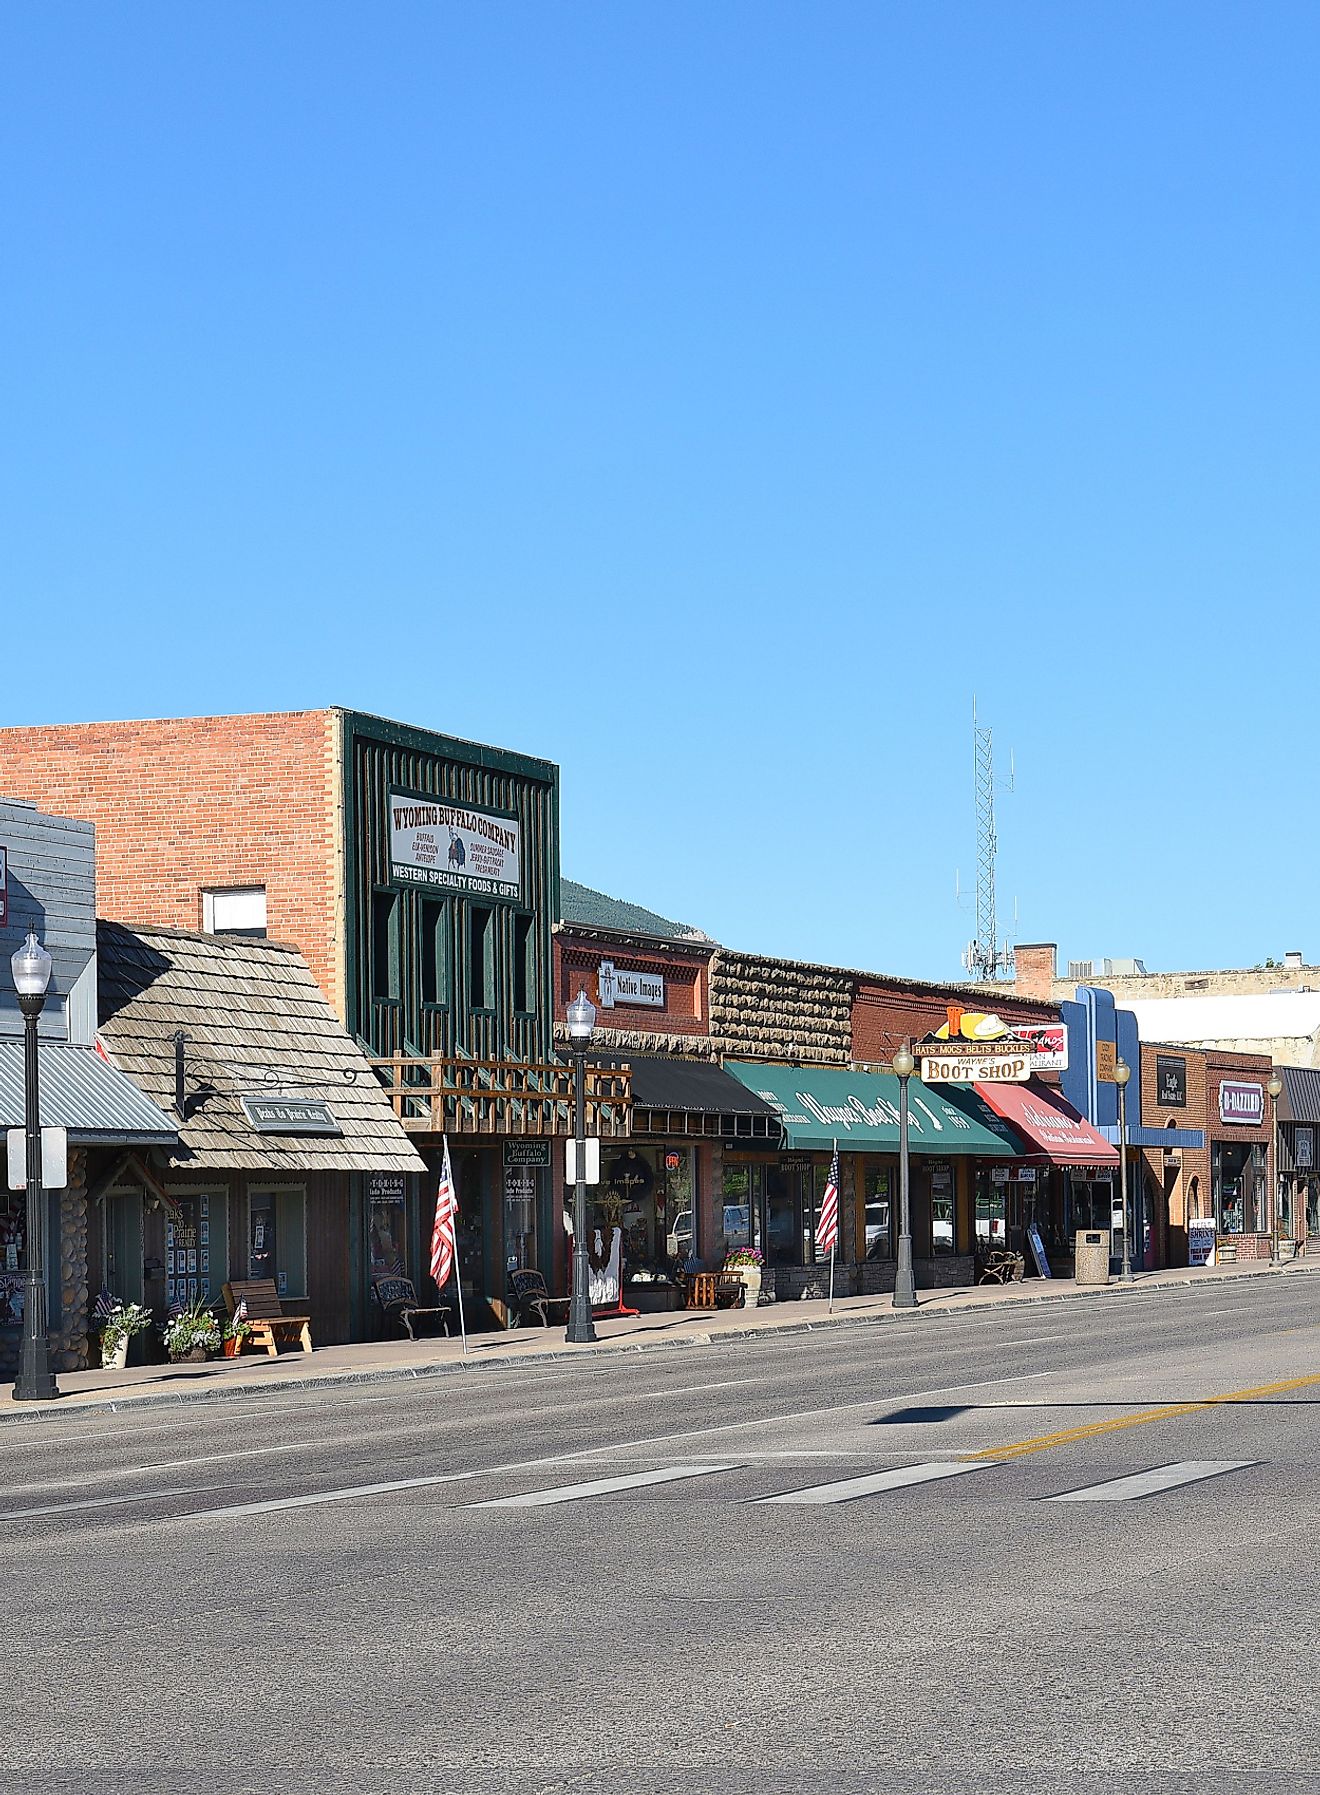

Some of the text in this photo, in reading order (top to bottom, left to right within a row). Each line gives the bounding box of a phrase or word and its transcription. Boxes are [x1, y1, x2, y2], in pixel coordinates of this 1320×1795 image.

[393, 807, 516, 854] WYOMING BUFFALO COMPANY
[392, 864, 519, 898] WESTERN SPECIALTY FOODS & GIFTS
[616, 975, 662, 1001] Native Images
[915, 1044, 1031, 1054] HATS MOCS BELTS BUCKLES
[957, 1057, 996, 1066] WAYNE'S
[927, 1059, 1026, 1080] BOOT SHOP
[508, 1141, 547, 1151] Wyoming
[512, 1149, 542, 1158] Buffalo
[507, 1155, 547, 1165] Company
